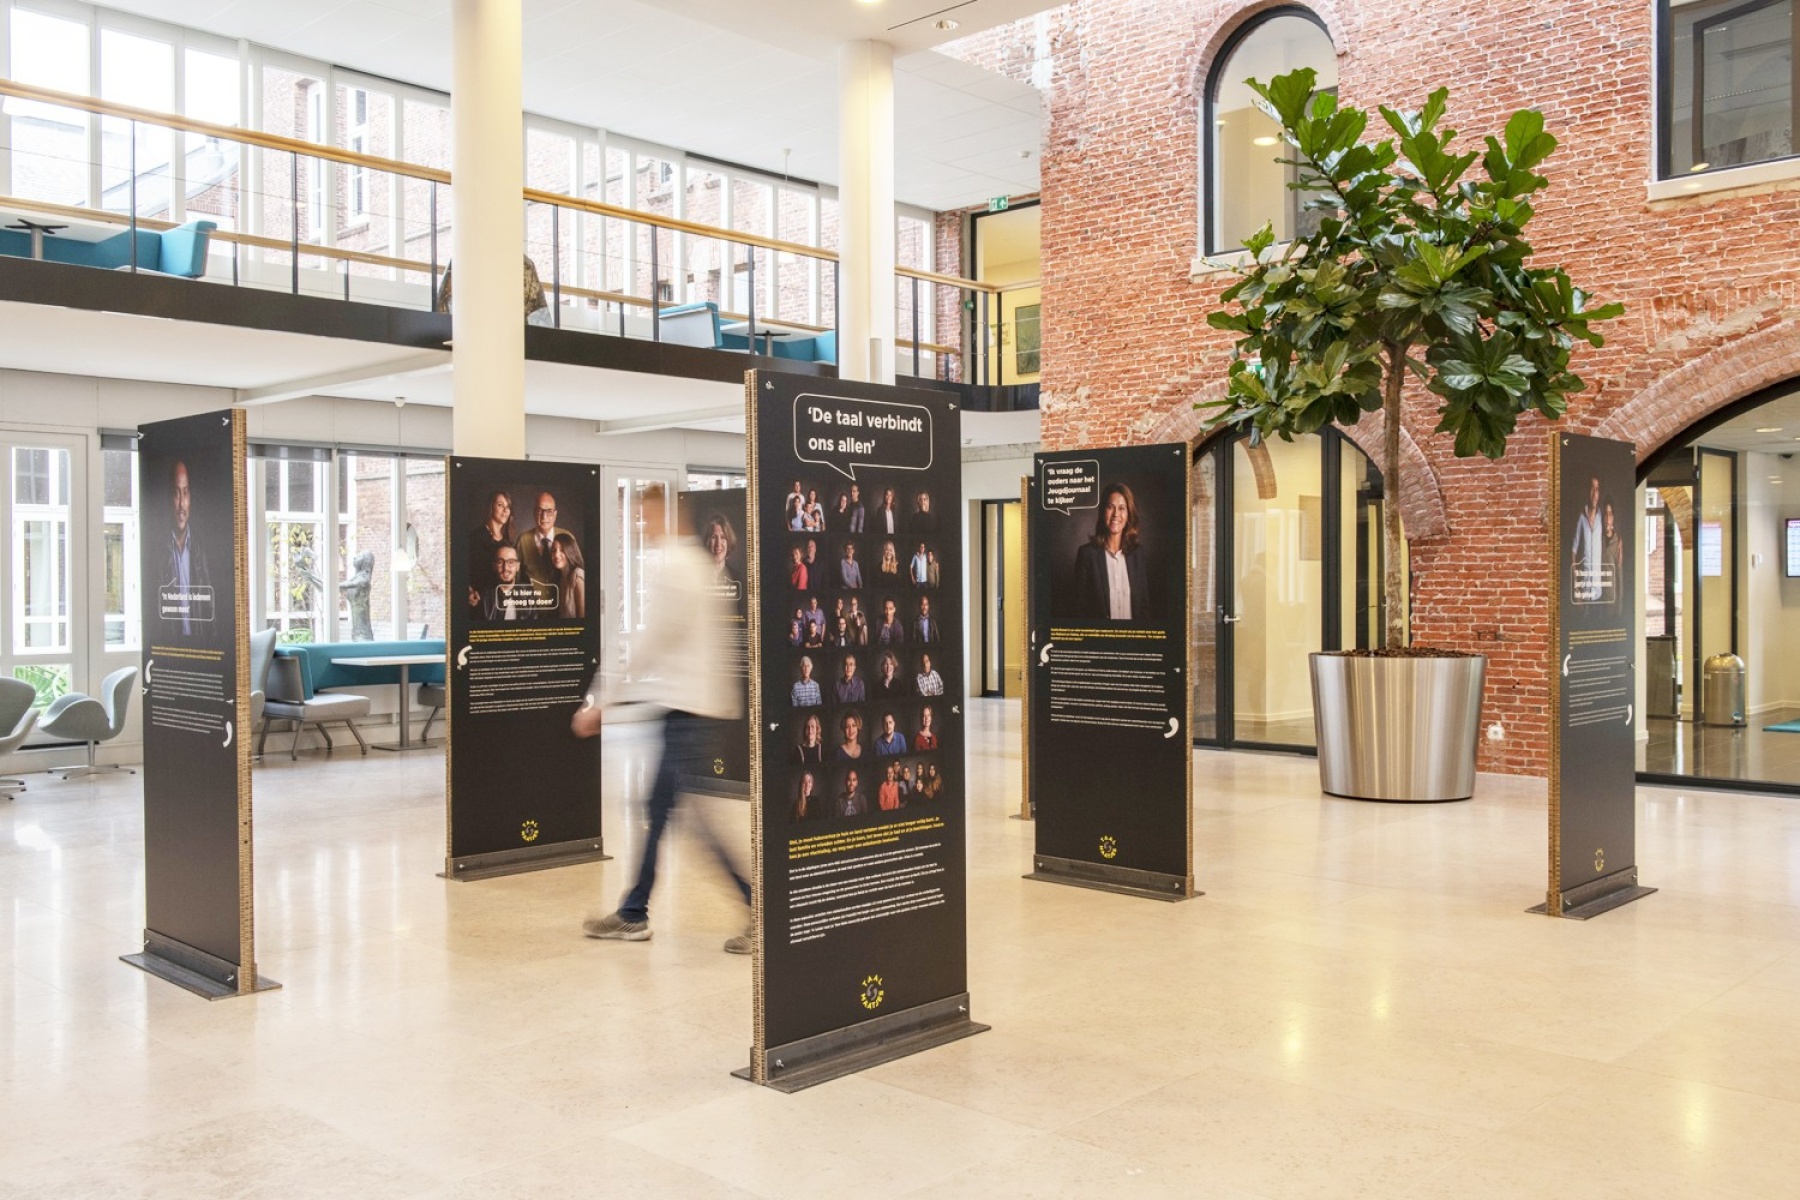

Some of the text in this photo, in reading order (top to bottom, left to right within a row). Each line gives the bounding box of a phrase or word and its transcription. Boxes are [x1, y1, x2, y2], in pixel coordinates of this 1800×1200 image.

[836, 409, 863, 427] taal
[866, 413, 923, 433] verbindt
[808, 437, 834, 452] ons
[1056, 468, 1073, 476] vraag
[1074, 466, 1083, 474] de
[1047, 477, 1068, 485] ouders
[503, 598, 527, 607] genoeg
[861, 974, 883, 987] TAAL
